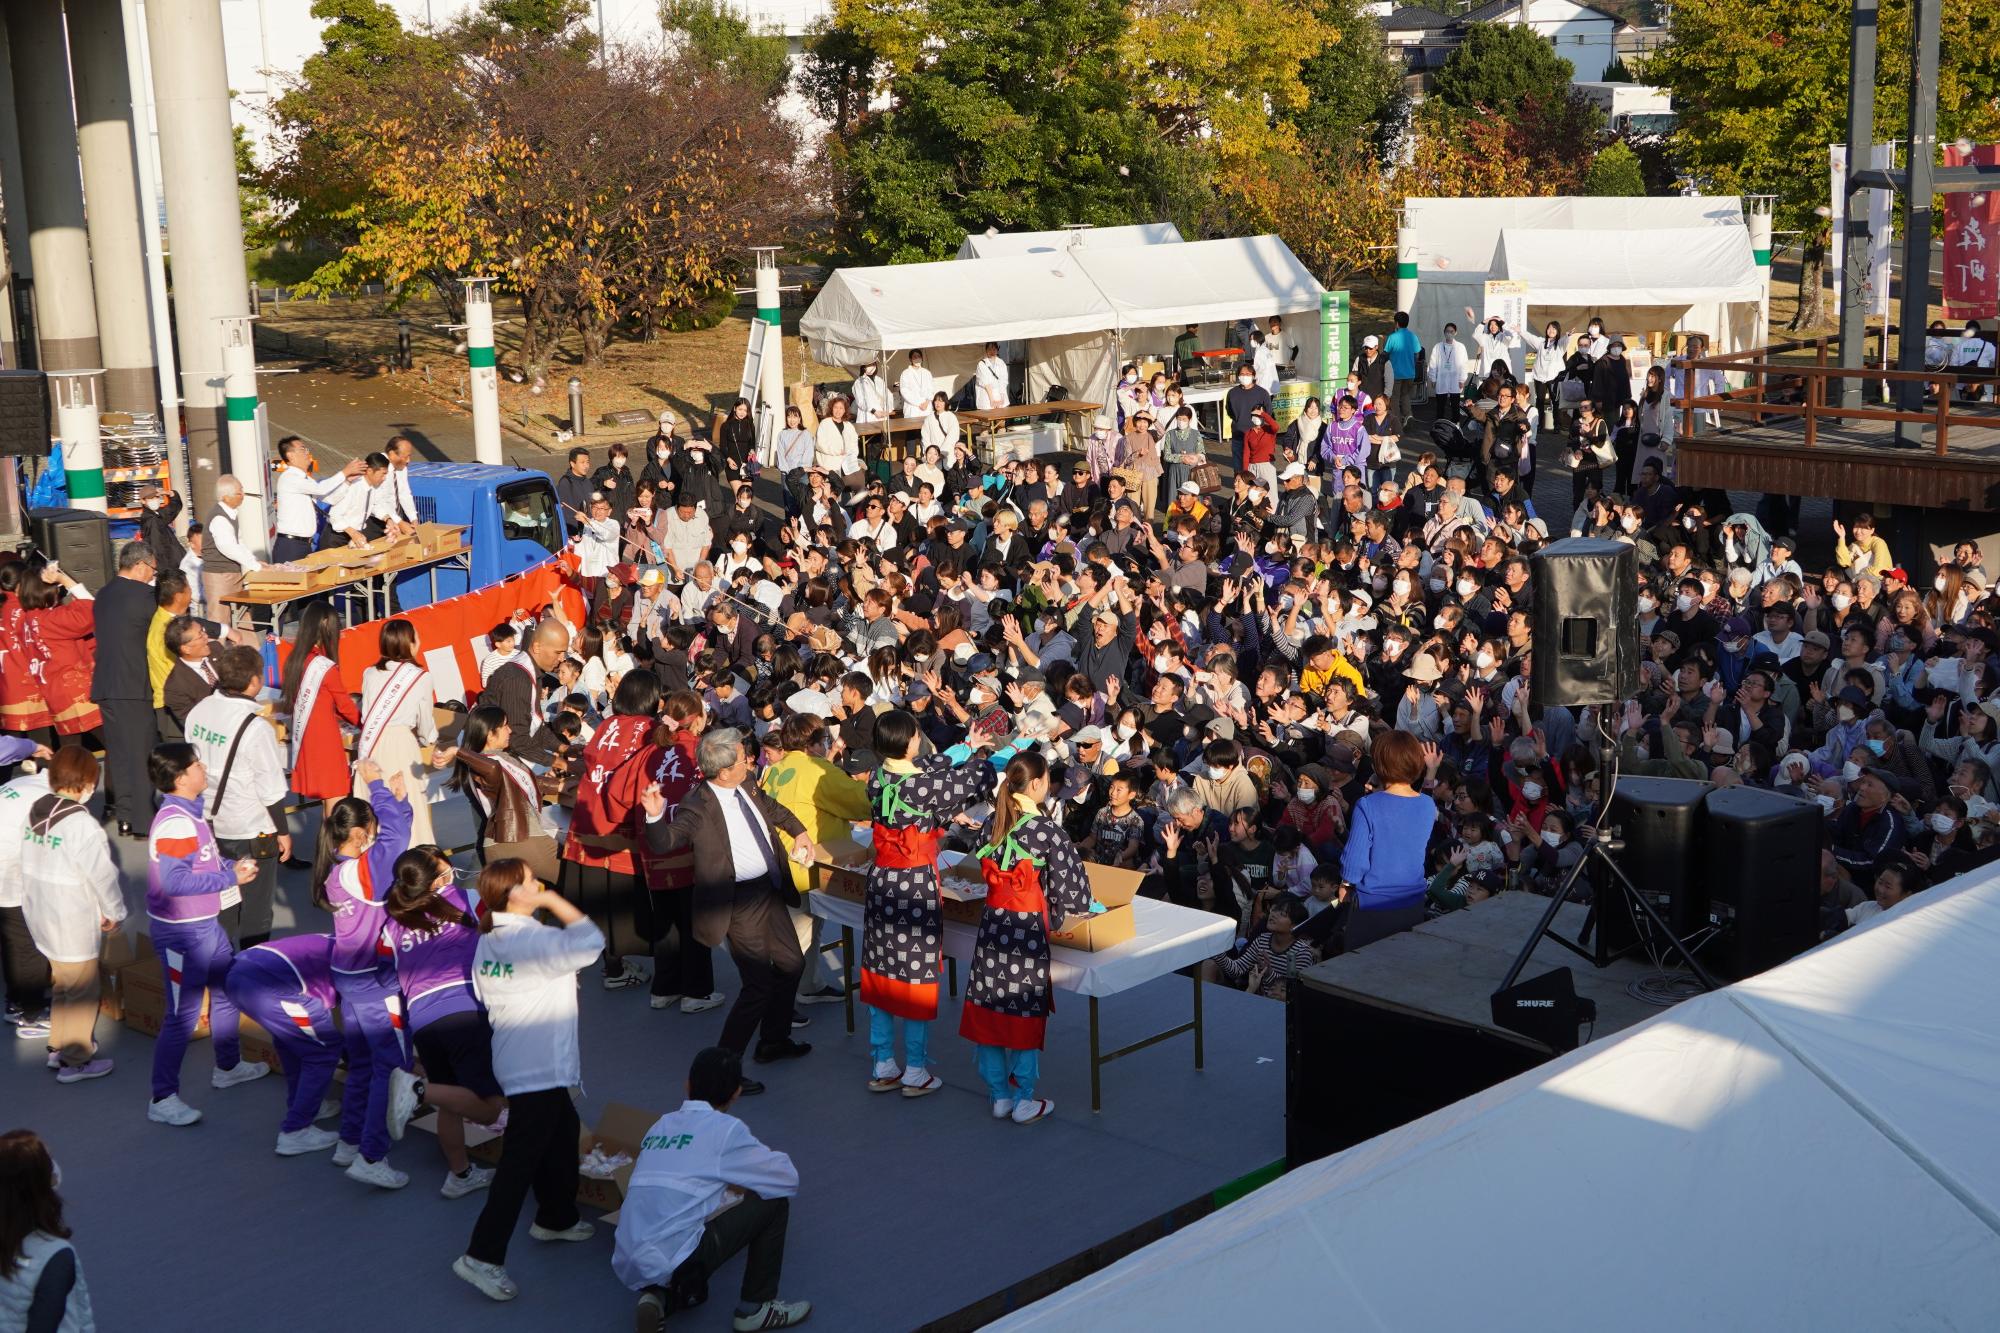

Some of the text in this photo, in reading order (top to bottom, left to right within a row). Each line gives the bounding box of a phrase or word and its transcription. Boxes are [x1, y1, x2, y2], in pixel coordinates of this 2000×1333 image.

[1327, 296, 1341, 379] コモコモ焼き
[1331, 436, 1354, 445] STAFF
[193, 724, 227, 747] STAFF
[641, 1134, 694, 1150] STAFF
